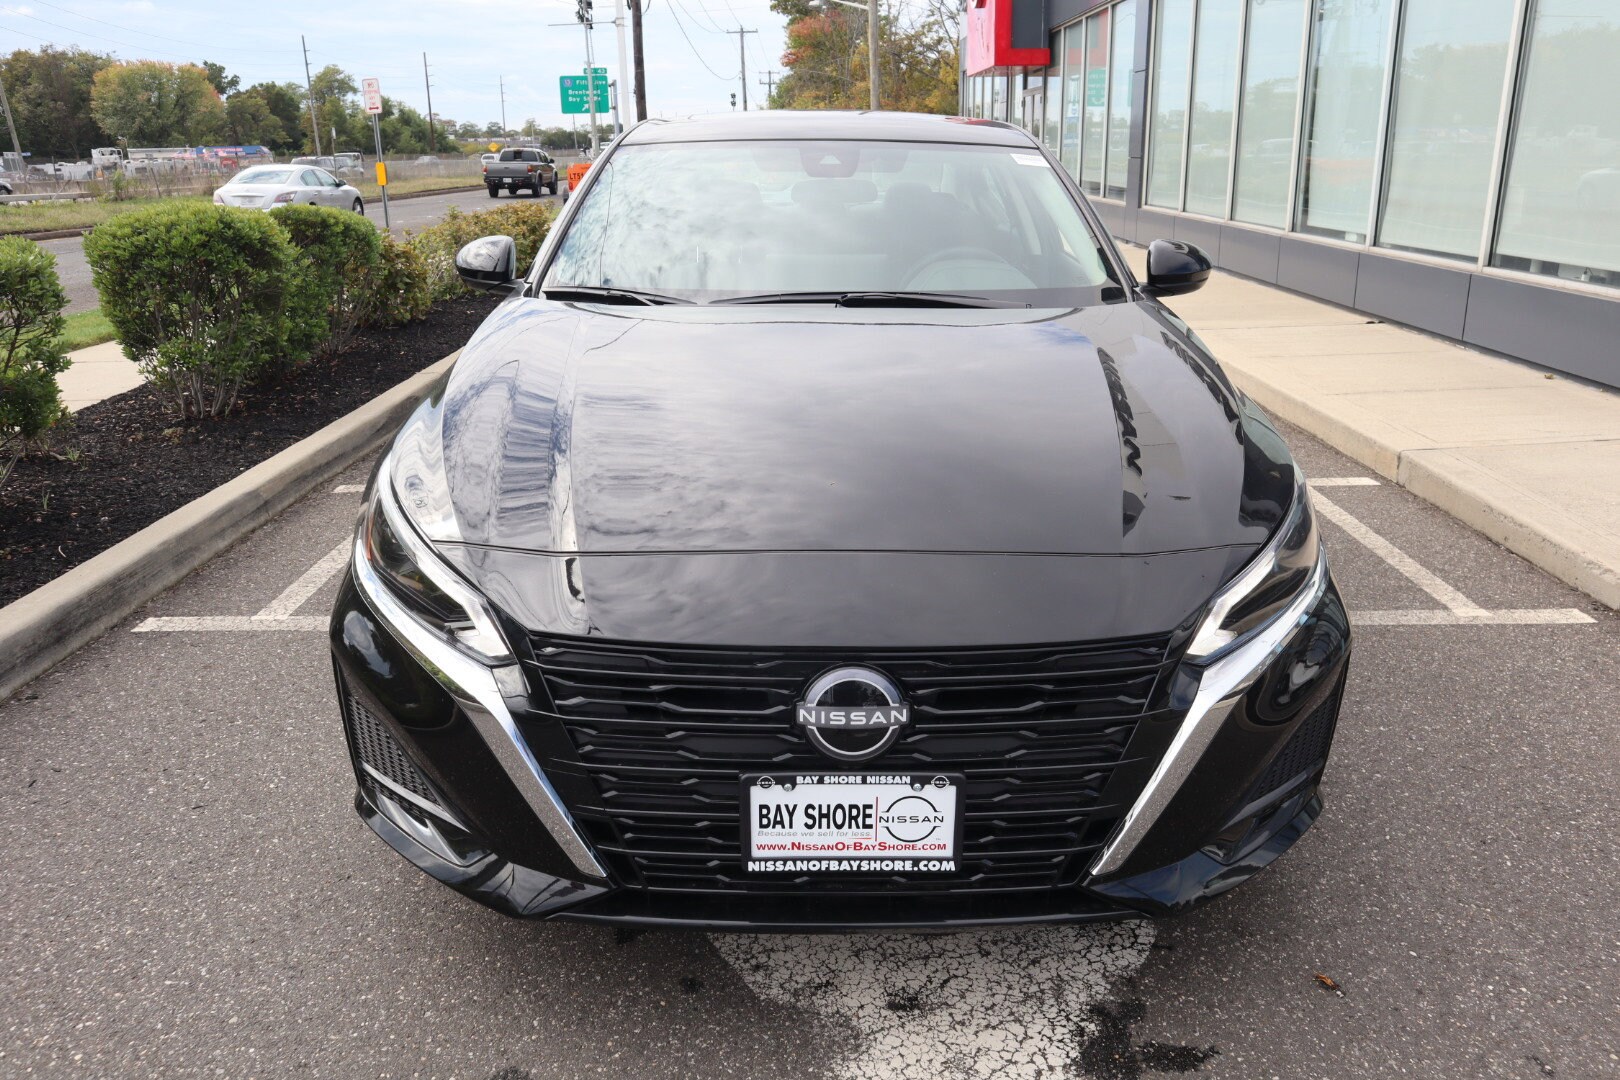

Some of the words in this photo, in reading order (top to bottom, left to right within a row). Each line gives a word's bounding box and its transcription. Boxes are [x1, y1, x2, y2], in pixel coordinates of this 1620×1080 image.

[800, 709, 907, 725] NISSAN
[796, 776, 820, 784] BAY
[824, 776, 862, 784] SHORE
[866, 776, 910, 784] NISSAN
[759, 804, 798, 829] BAY
[804, 803, 873, 830] SHORE
[748, 860, 956, 871] NISSANOFBAYSHORE.COM
